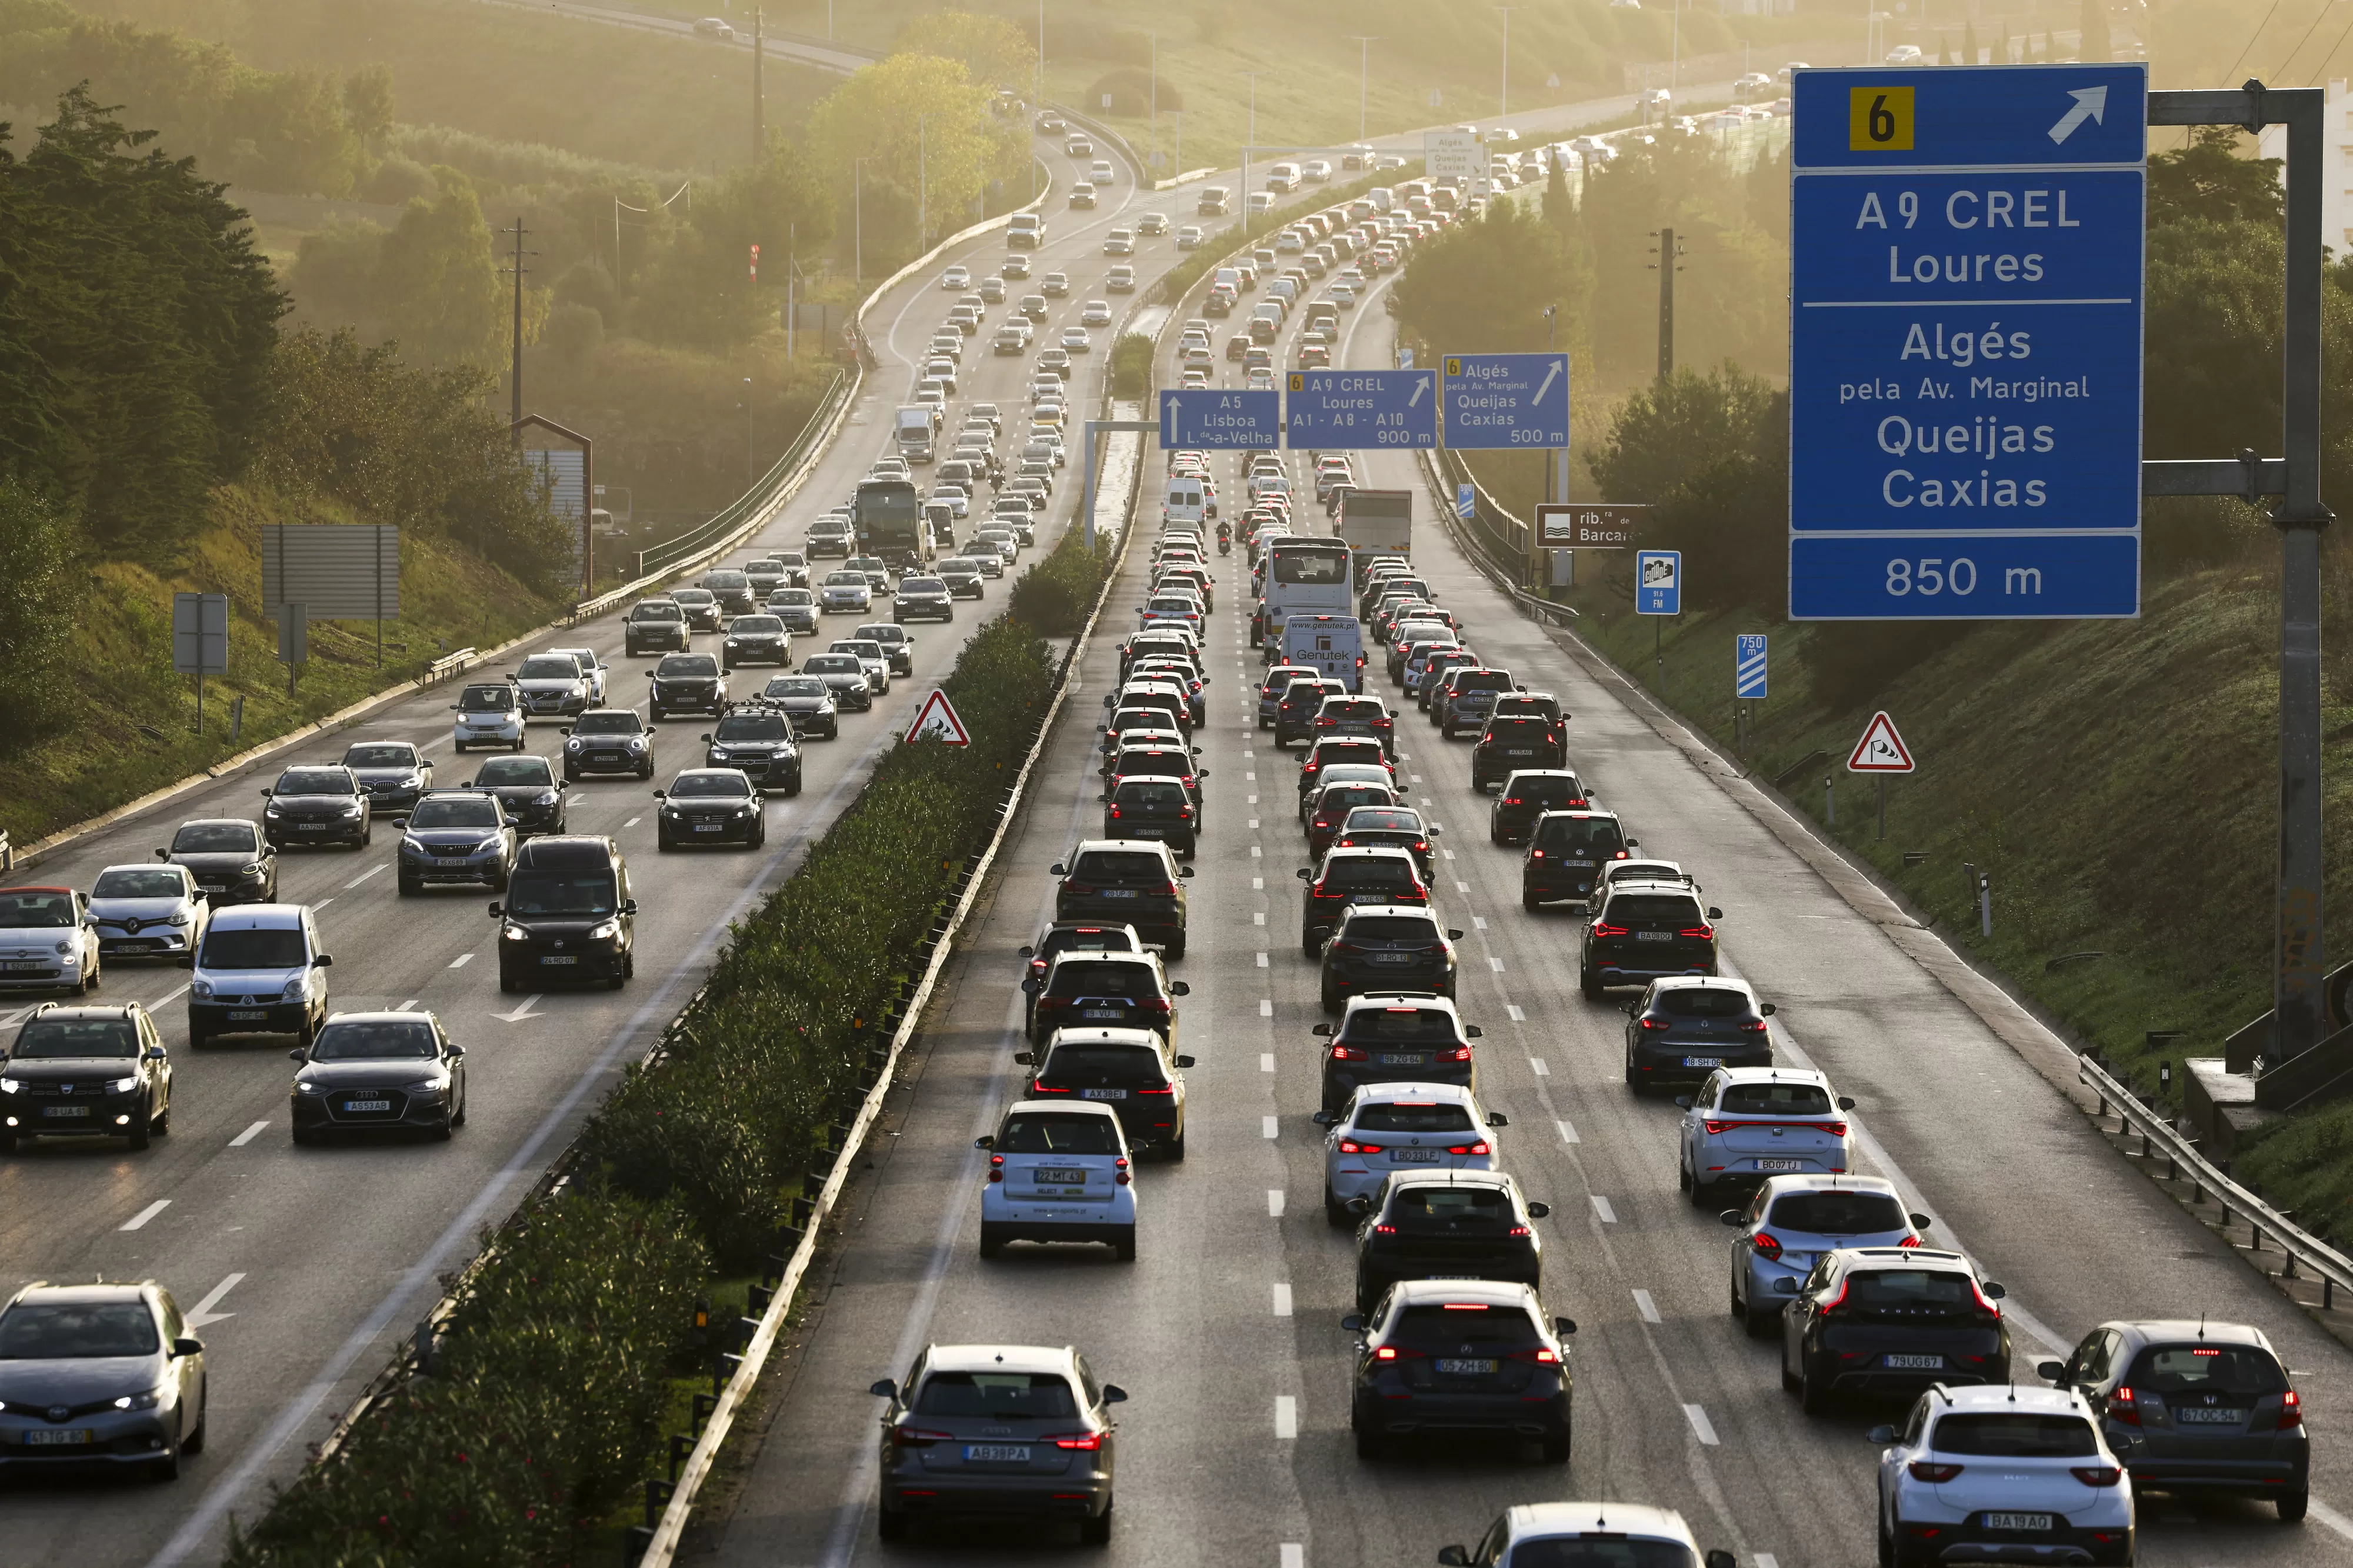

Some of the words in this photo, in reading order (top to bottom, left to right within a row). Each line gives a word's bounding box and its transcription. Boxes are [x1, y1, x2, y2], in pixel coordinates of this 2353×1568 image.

[1868, 95, 1895, 143] 6
[1439, 139, 1462, 147] Algés
[1434, 155, 1467, 163] Queijas
[1946, 189, 2081, 228] CREL
[1889, 246, 2044, 283] Loures
[1900, 322, 2032, 368] Algés
[1449, 360, 1457, 374] 6
[1466, 364, 1509, 380] Algés
[1292, 375, 1301, 391] 6
[1341, 378, 1385, 391] CREL
[1446, 383, 1467, 392] pela
[1471, 382, 1484, 391] Av.
[1489, 381, 1528, 391] Marginal
[1840, 378, 1901, 404] pela
[1918, 378, 1955, 399] Av.
[1970, 375, 2089, 403] Marginal
[1322, 396, 1374, 409] Loures
[1458, 395, 1517, 410] Queijas
[1204, 413, 1255, 426] Lisboa
[1460, 412, 1515, 426] Caxias
[1378, 431, 1410, 443] 900
[1418, 433, 1431, 443] m
[1511, 429, 1542, 443] 500
[1551, 432, 1563, 442] m
[1877, 415, 2055, 461] Queijas
[1883, 469, 2047, 508] Caxias
[1645, 563, 1667, 582] CIDADE
[1885, 558, 1977, 596] 850
[2006, 565, 2041, 595] m
[1654, 599, 1662, 608] FM
[1292, 623, 1355, 631] www.genutek.pt
[1741, 636, 1762, 648] 750
[1297, 649, 1349, 660] Genutek
[1086, 1010, 1121, 1018] 19-VU-11
[1385, 1055, 1420, 1064] 98-ZG-64
[1089, 1090, 1122, 1098] AX38EI
[351, 1102, 386, 1110] AS53AB
[1398, 1150, 1435, 1161] BD33LF
[1762, 1161, 1797, 1170] BD07TJ
[1442, 1359, 1492, 1372] 05-ZH-80
[1892, 1356, 1937, 1367] 79UG67
